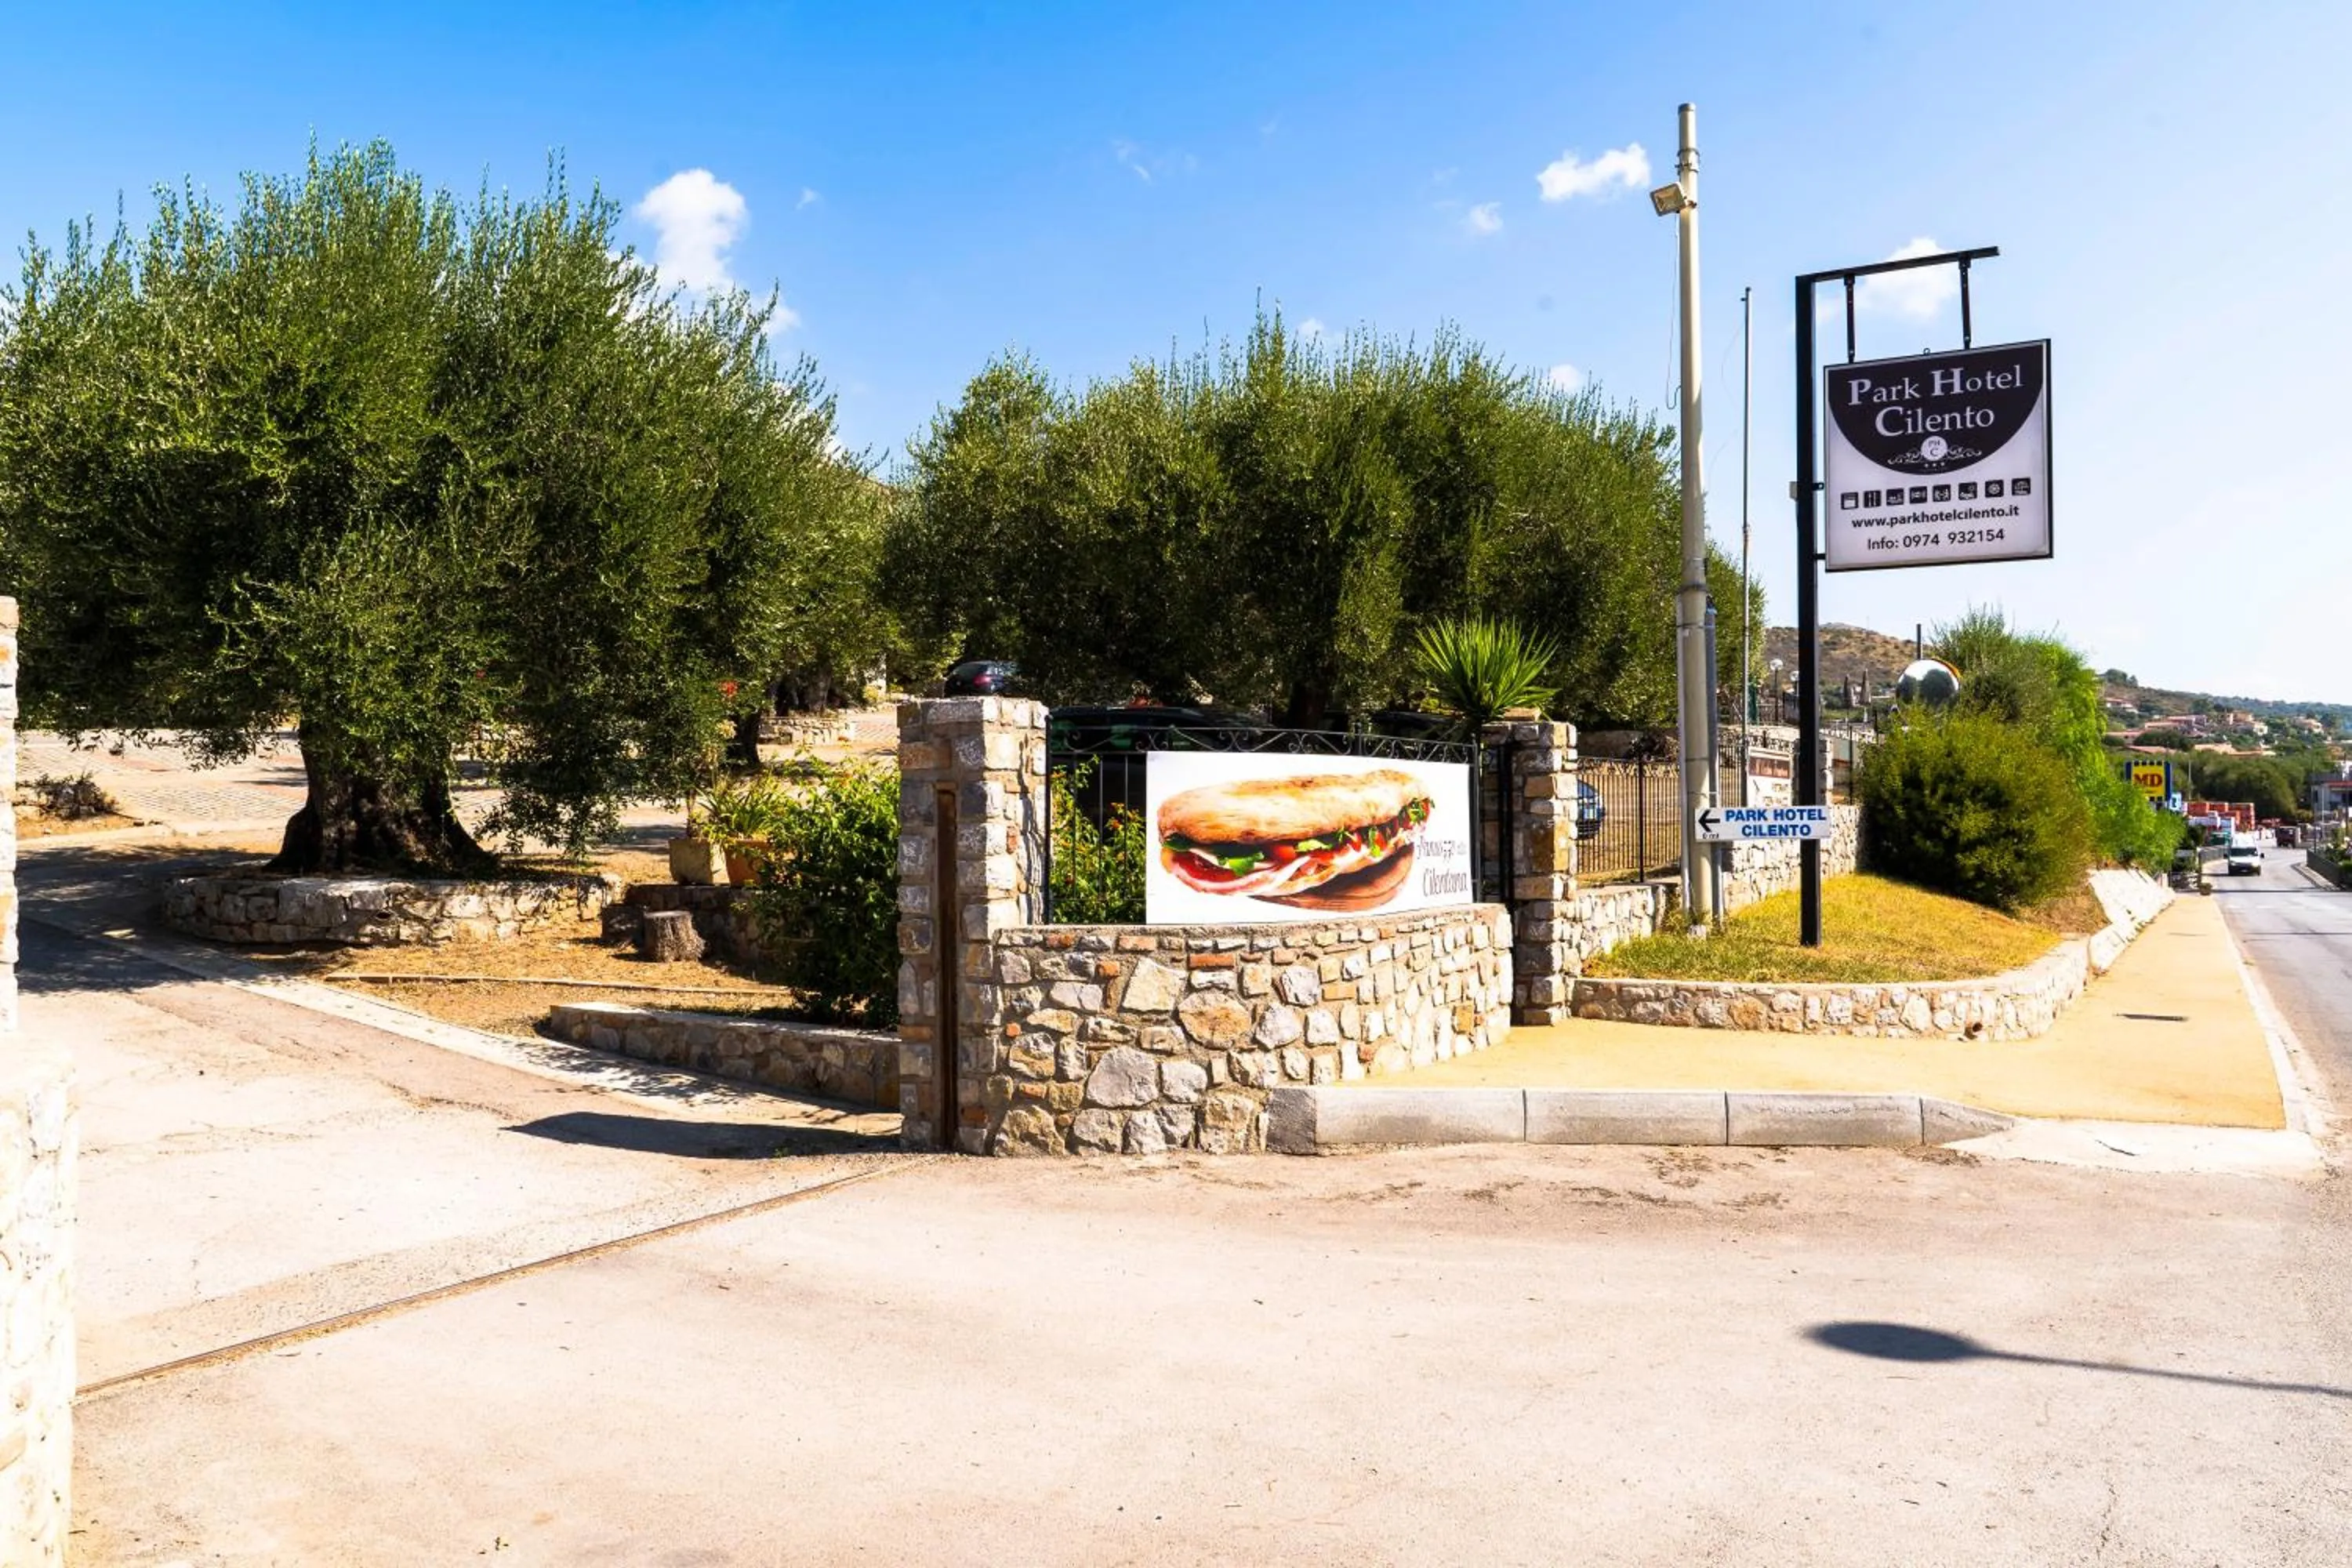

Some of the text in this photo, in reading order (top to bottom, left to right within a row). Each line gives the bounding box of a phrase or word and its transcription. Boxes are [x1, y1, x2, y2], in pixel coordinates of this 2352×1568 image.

[1847, 365, 2024, 405] Park Hotel
[1875, 406, 1994, 437] Cilento
[1851, 505, 2020, 528] www.parkhotelcilento.it
[1867, 528, 2005, 550] Info: 0974 932154
[2133, 773, 2163, 787] MD
[1726, 808, 1827, 822] PARK HOTEL
[1741, 824, 1811, 837] CILENTO
